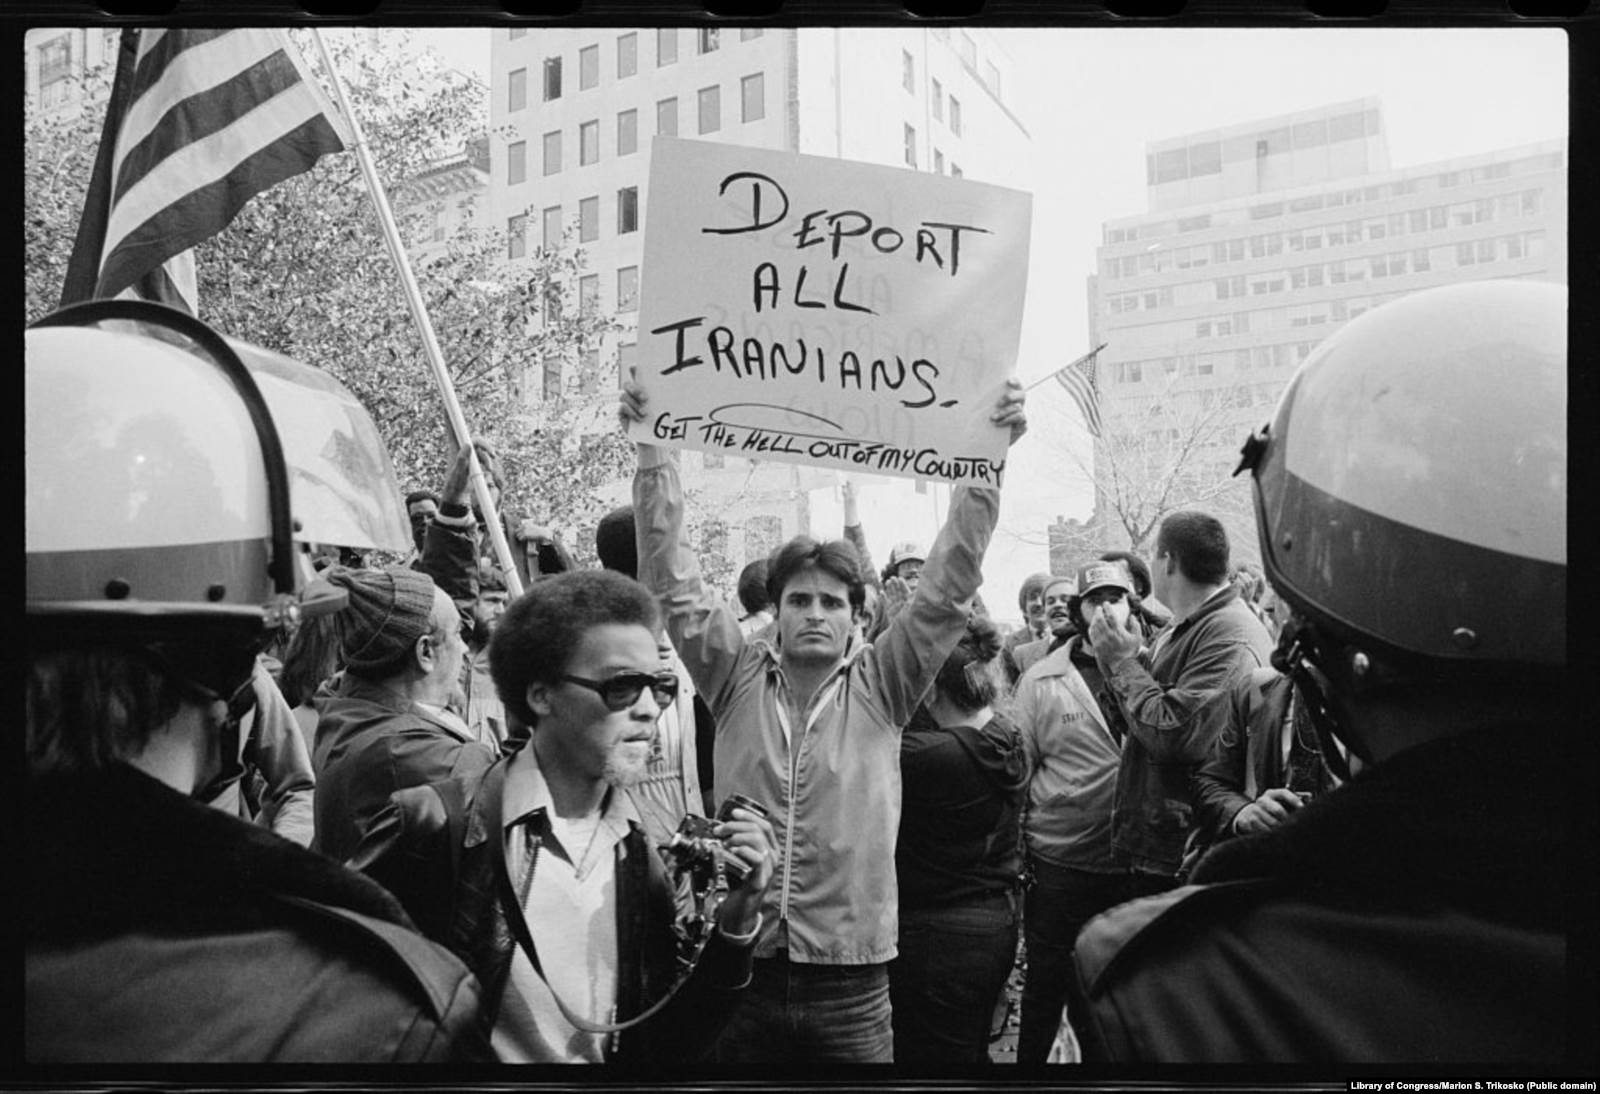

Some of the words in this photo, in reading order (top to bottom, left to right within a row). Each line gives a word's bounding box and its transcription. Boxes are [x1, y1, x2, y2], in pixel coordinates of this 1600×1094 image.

[702, 172, 994, 276] DEPORT
[753, 262, 880, 315] ALL
[653, 412, 703, 440] GET
[699, 421, 736, 448] THE
[741, 428, 804, 454] HELL
[808, 441, 860, 459] OUT
[878, 448, 916, 472] MY
[913, 449, 1005, 488] COUNTRY
